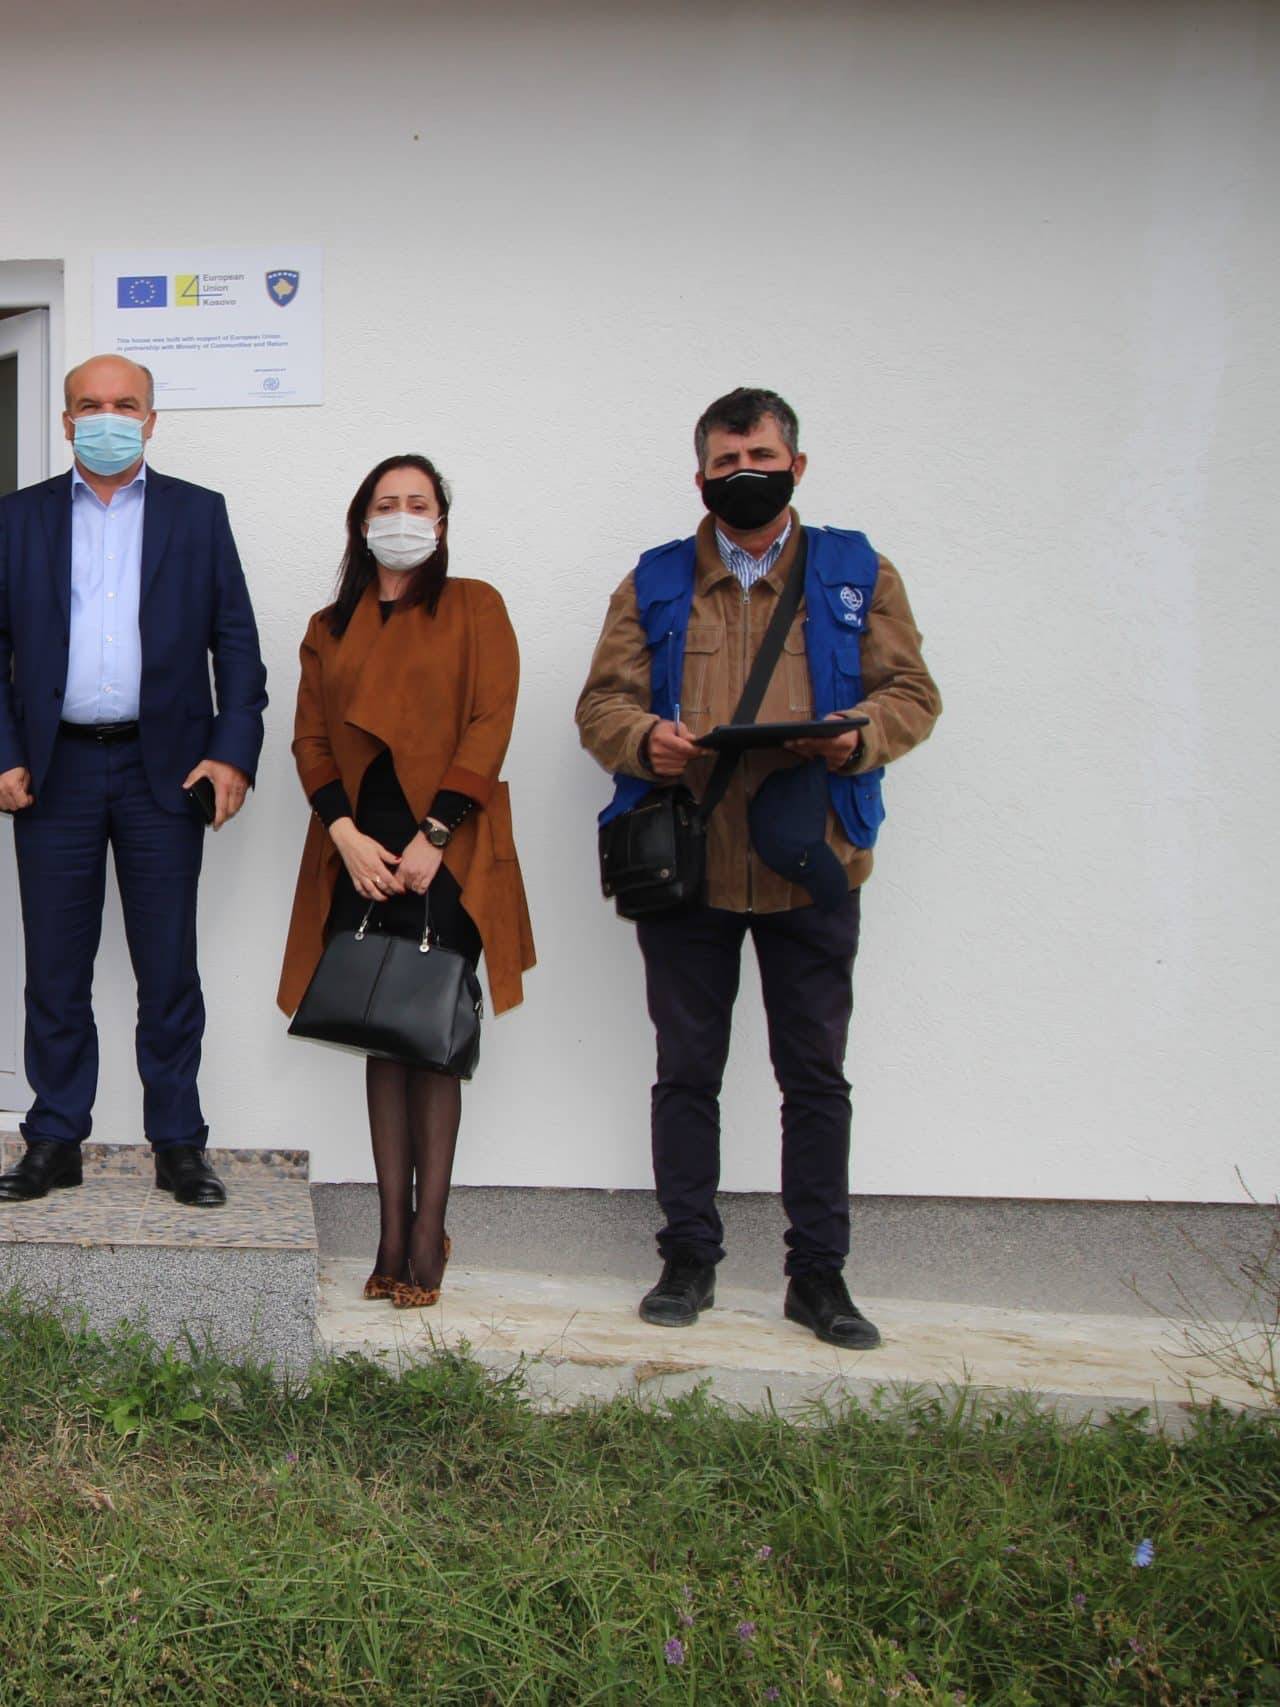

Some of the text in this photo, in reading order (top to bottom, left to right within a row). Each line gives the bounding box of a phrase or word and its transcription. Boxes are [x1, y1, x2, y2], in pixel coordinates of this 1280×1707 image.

[203, 274, 245, 282] European
[197, 335, 221, 343] support
[230, 334, 260, 342] European
